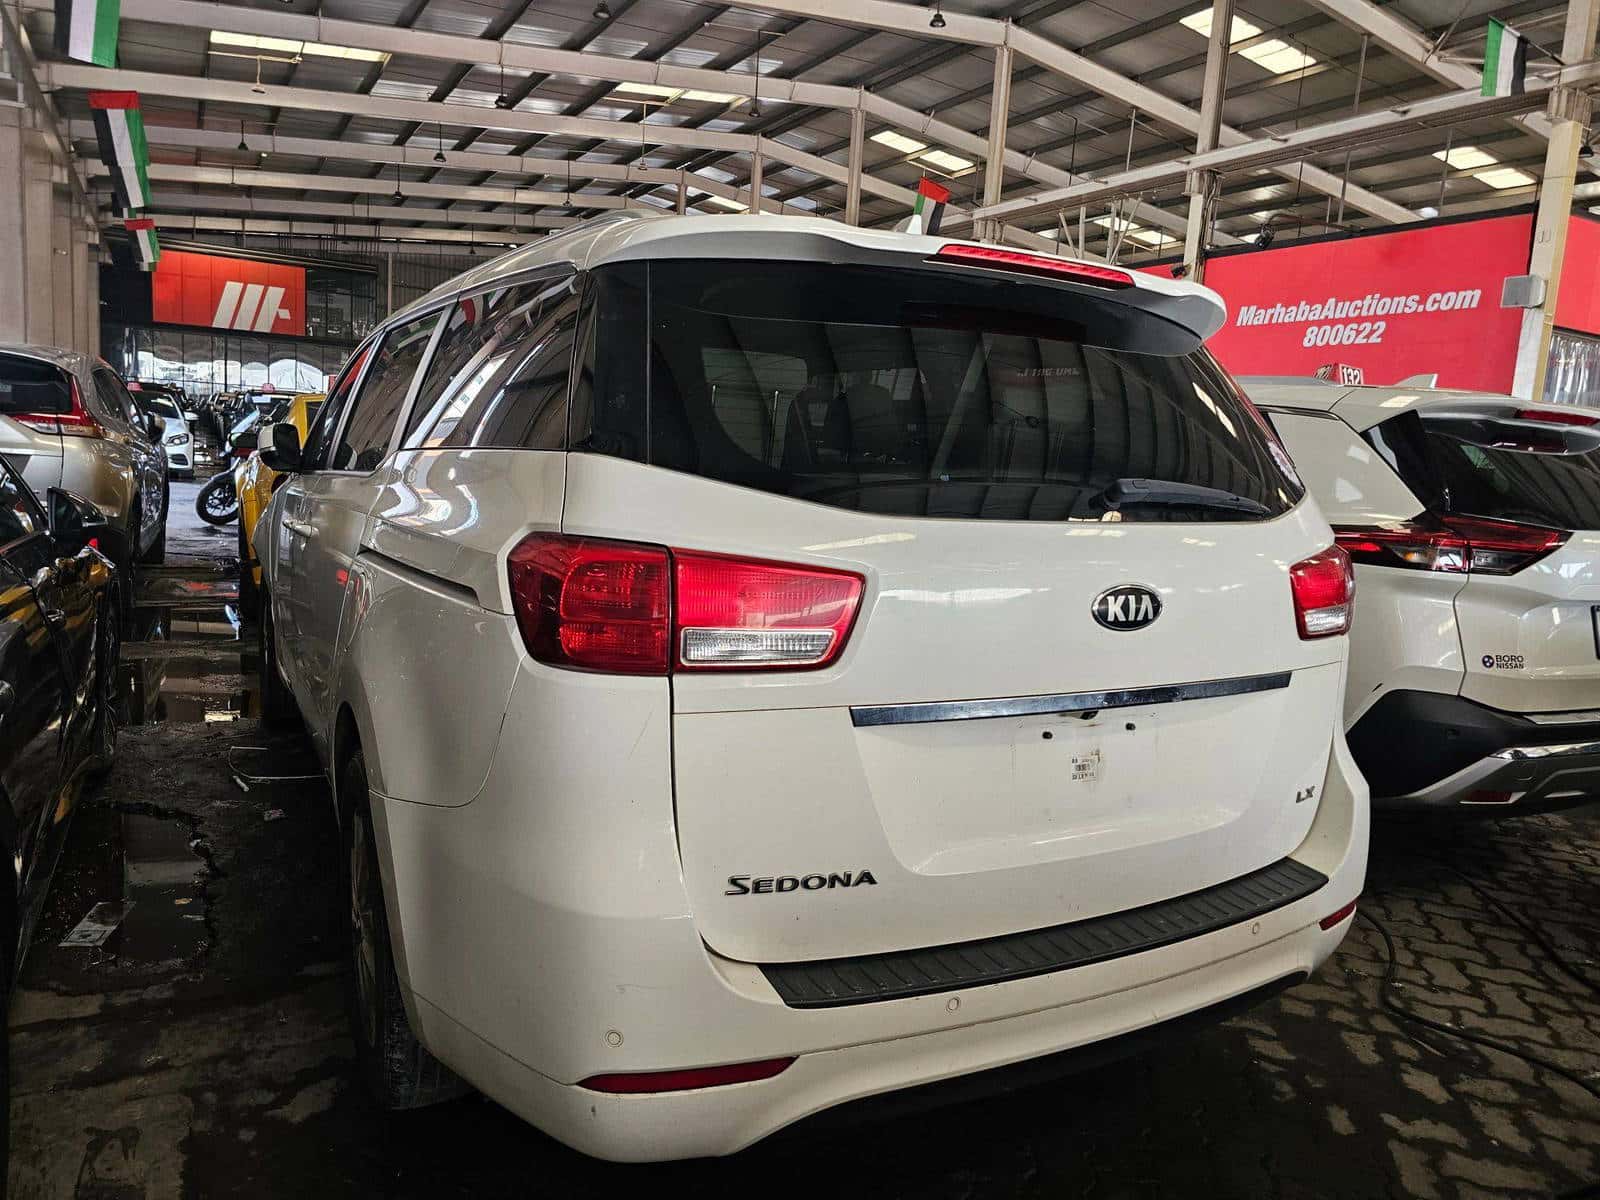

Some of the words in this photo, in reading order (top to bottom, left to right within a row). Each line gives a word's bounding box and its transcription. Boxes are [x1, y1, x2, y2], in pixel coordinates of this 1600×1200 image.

[1236, 289, 1482, 327] MarhabaAuctions.com
[1303, 321, 1386, 347] 800622
[1106, 594, 1154, 622] KIA
[1495, 654, 1524, 663] BORO
[1496, 662, 1524, 670] NISSAN
[1295, 785, 1315, 803] LX
[724, 869, 878, 896] SEDONA
